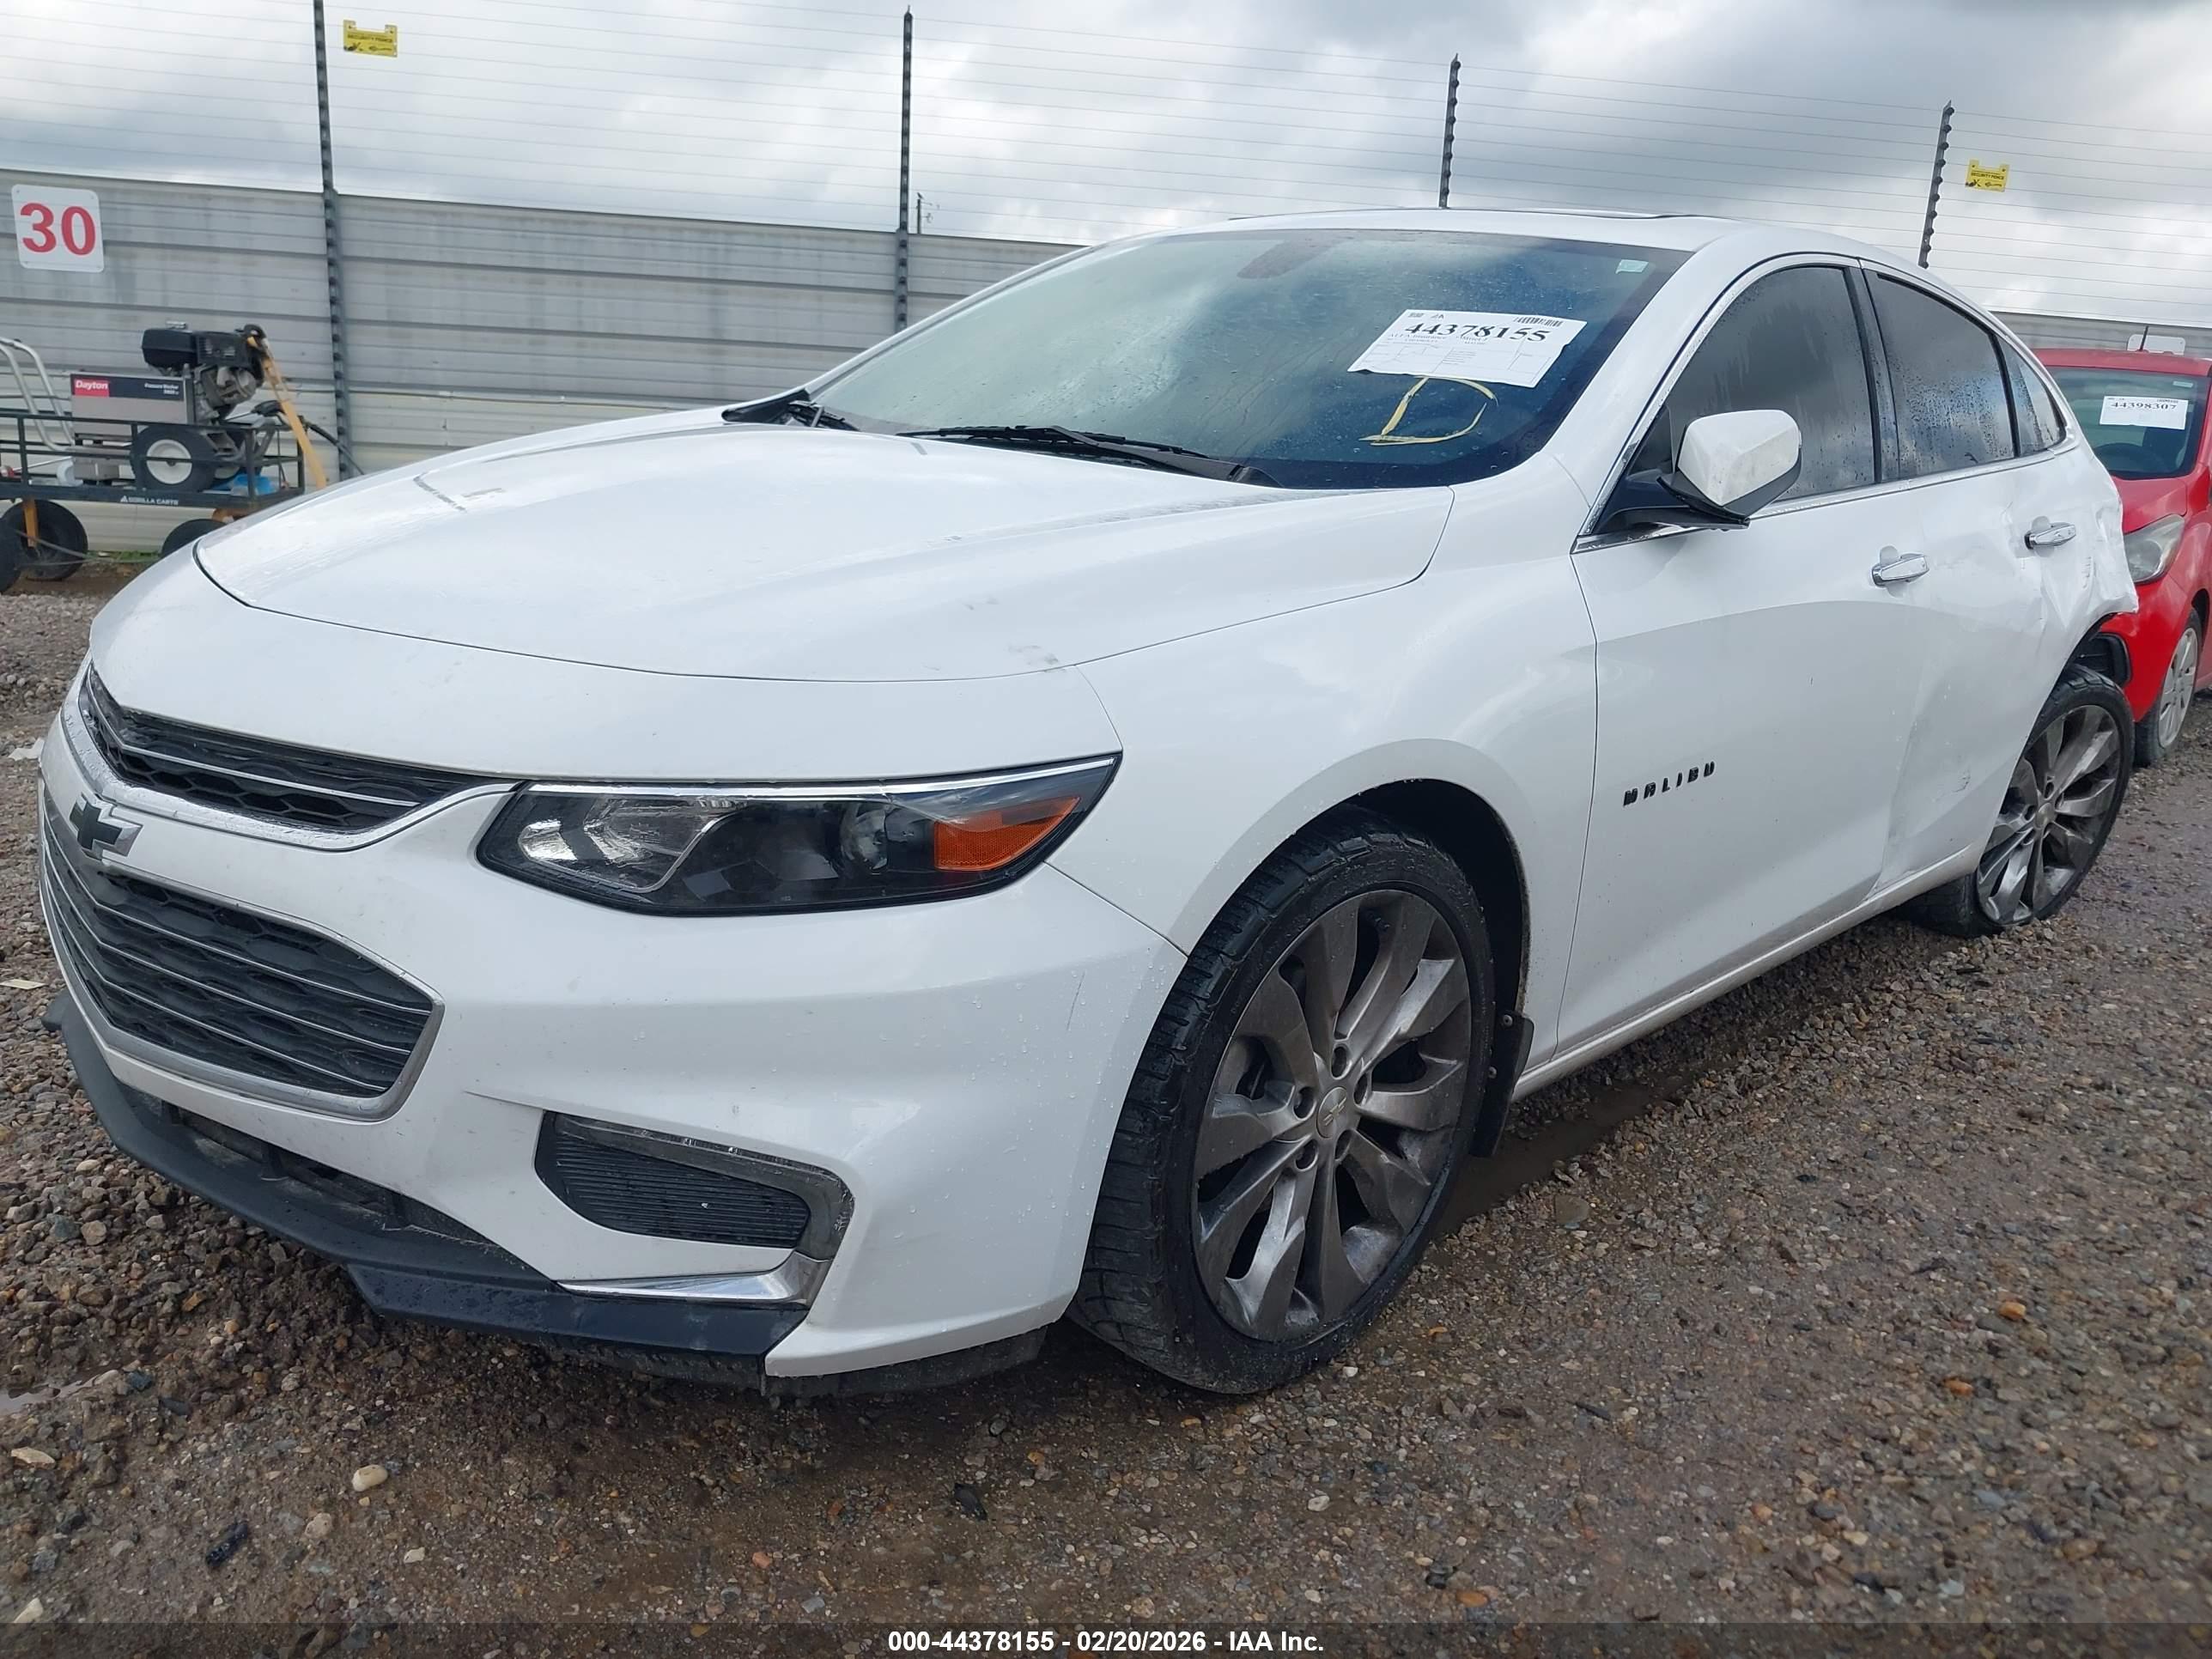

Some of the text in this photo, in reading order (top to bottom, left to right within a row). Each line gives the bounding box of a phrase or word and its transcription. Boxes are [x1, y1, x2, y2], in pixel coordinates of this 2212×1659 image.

[20, 203, 96, 256] 30
[1405, 323, 1551, 342] 44378155
[75, 380, 108, 391] Dayton
[2111, 401, 2178, 410] 44398307
[1623, 761, 1716, 807] MALIBU
